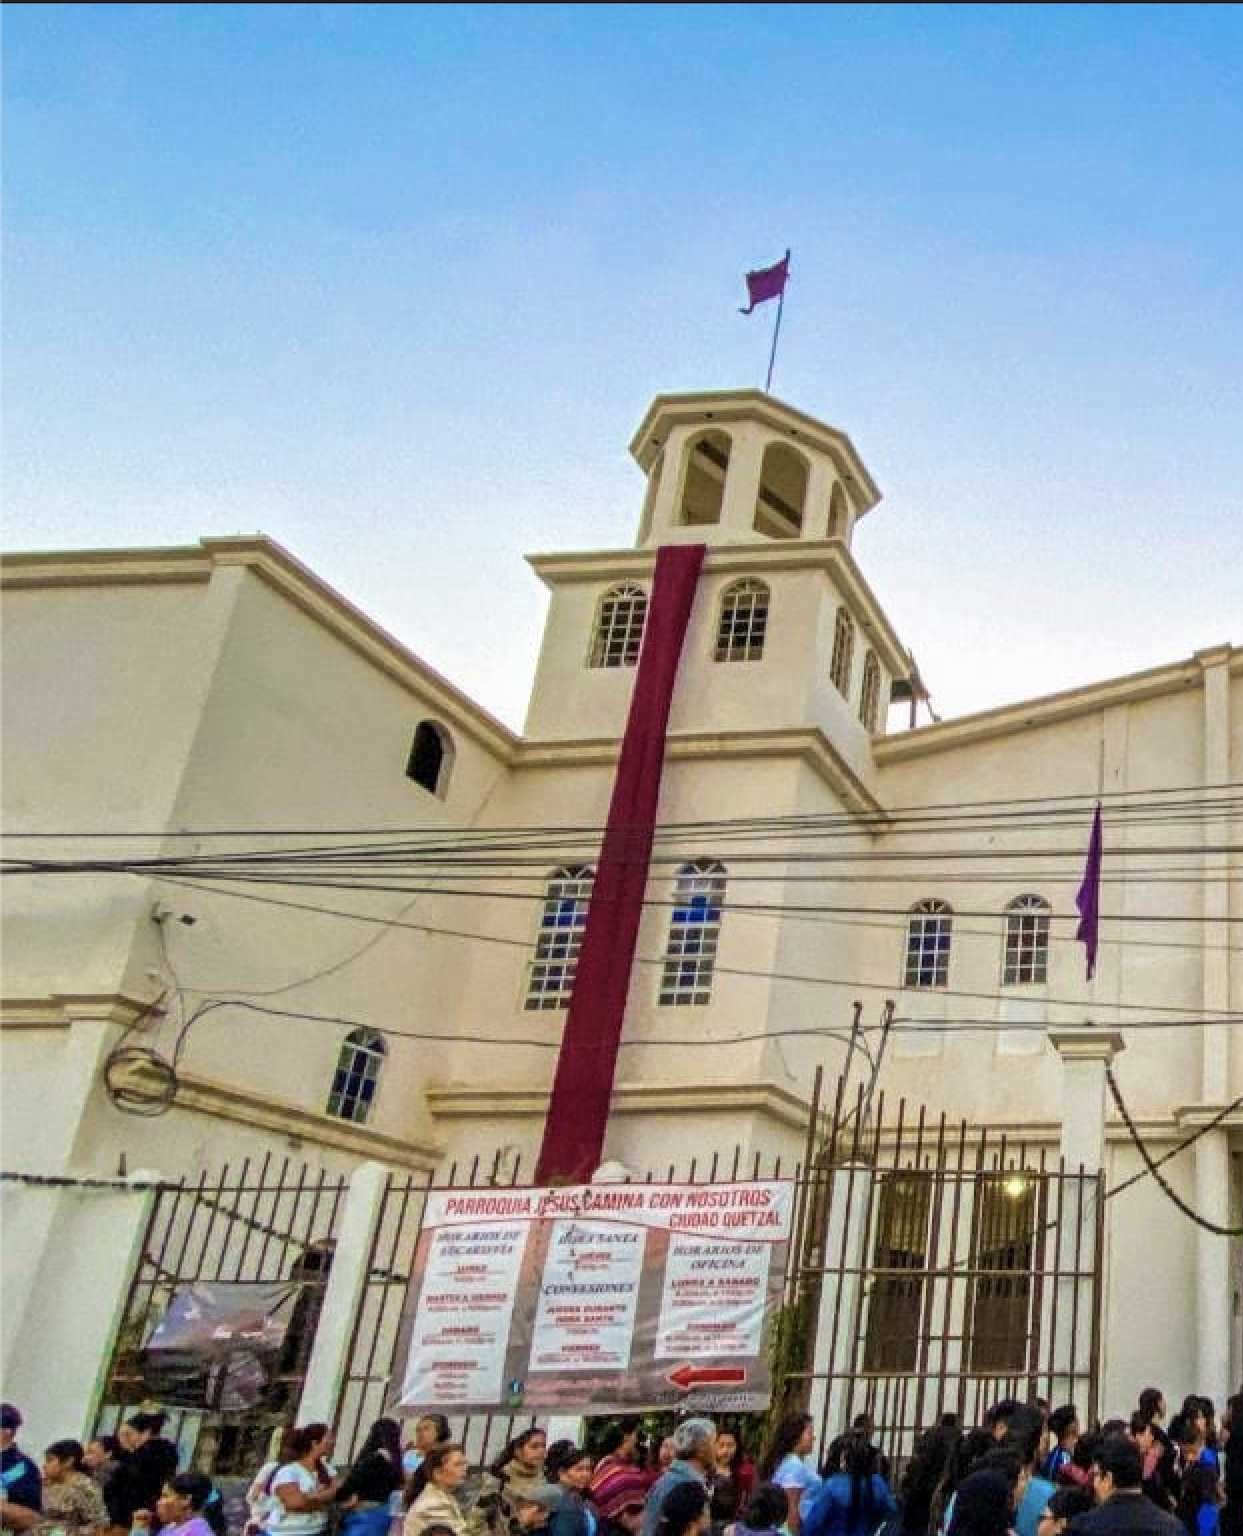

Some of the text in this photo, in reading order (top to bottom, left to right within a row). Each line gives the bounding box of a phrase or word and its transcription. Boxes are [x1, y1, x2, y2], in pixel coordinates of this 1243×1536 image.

[446, 1197, 530, 1215] PARROQUIA
[583, 1192, 644, 1211] CAMINA
[649, 1192, 682, 1209] CON
[686, 1189, 771, 1208] NOSOTROS
[670, 1210, 781, 1227] CIUDAD QUETZAL
[437, 1230, 521, 1242] HORARIOS DE
[672, 1245, 761, 1256] HORARIOS DE
[690, 1259, 745, 1270] OFICINA
[545, 1283, 634, 1296] CONFESIONES
